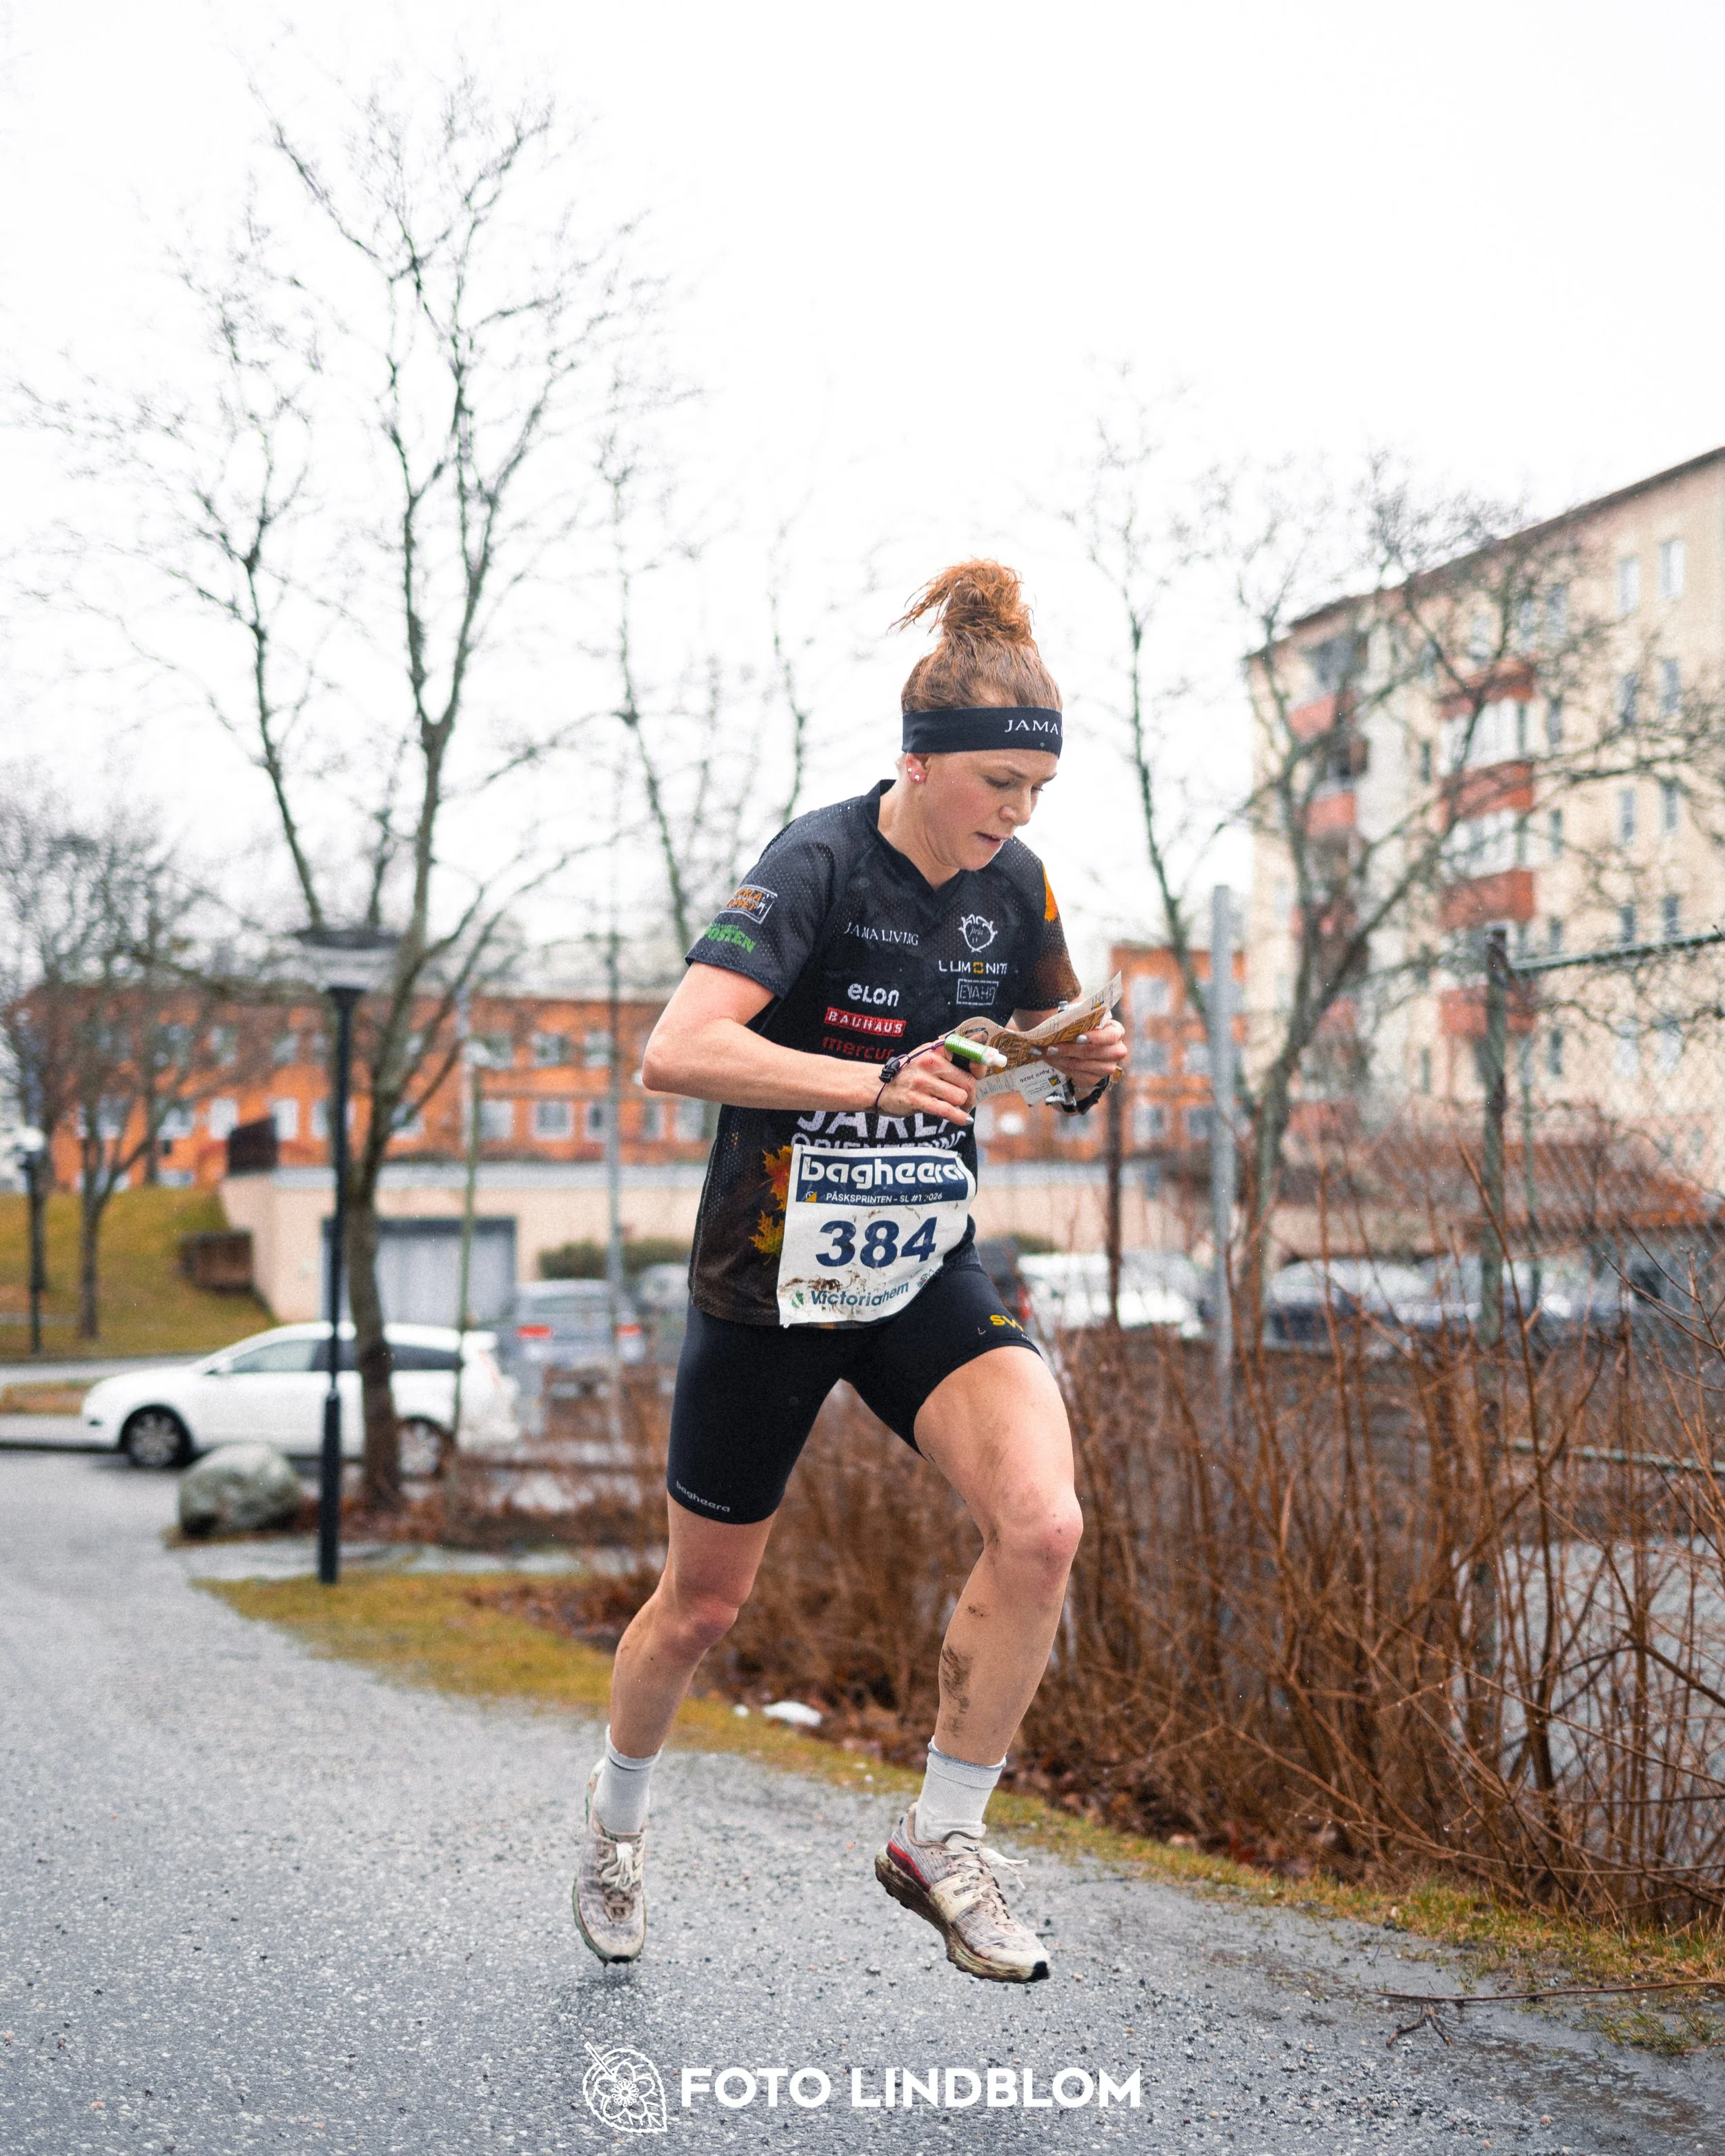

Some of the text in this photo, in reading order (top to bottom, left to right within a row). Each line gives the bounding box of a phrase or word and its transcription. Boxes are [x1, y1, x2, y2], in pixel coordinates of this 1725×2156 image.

[1005, 719, 1059, 735] JAMA
[843, 922, 878, 940] JAMA
[828, 1011, 903, 1034] BAUHAUS
[800, 1156, 966, 1189] bagheera
[826, 1190, 893, 1204] PÅSKSPRINTEN
[899, 1194, 909, 1203] SL
[911, 1194, 922, 1203] #1
[815, 1216, 938, 1269] 384
[810, 1281, 909, 1307] Victoriahem
[676, 1480, 731, 1512] bagheera
